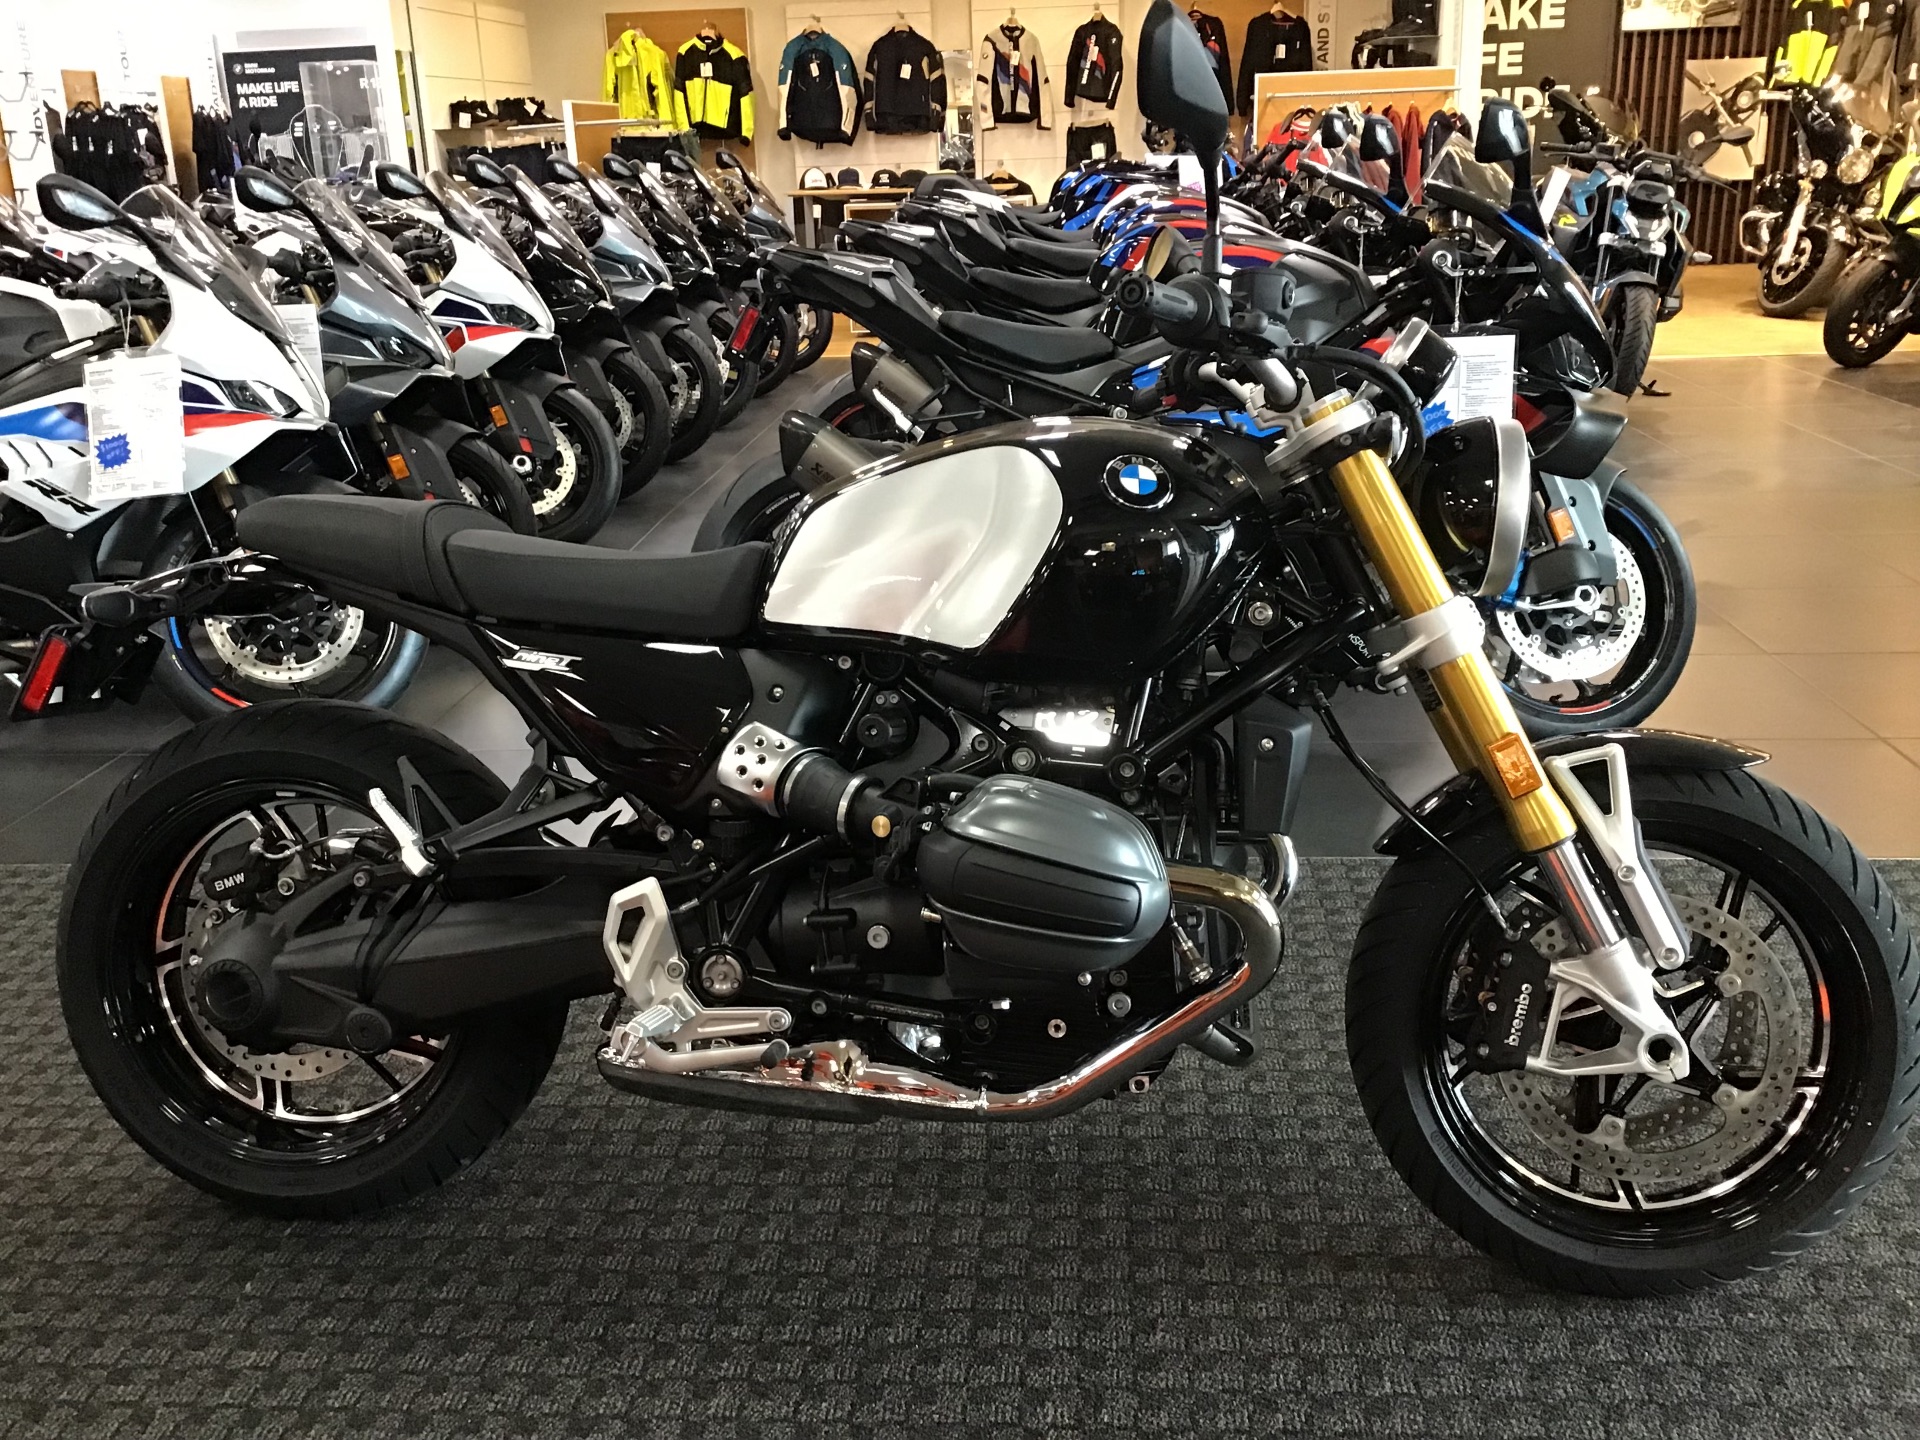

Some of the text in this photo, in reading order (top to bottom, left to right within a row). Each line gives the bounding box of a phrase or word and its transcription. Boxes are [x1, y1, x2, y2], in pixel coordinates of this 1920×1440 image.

[1317, 28, 1329, 64] AND
[236, 81, 300, 95] MAKE LIFE
[238, 95, 278, 109] A RIDE
[1112, 456, 1164, 474] BMW
[214, 872, 245, 892] BMW
[1503, 983, 1533, 1047] brembo
